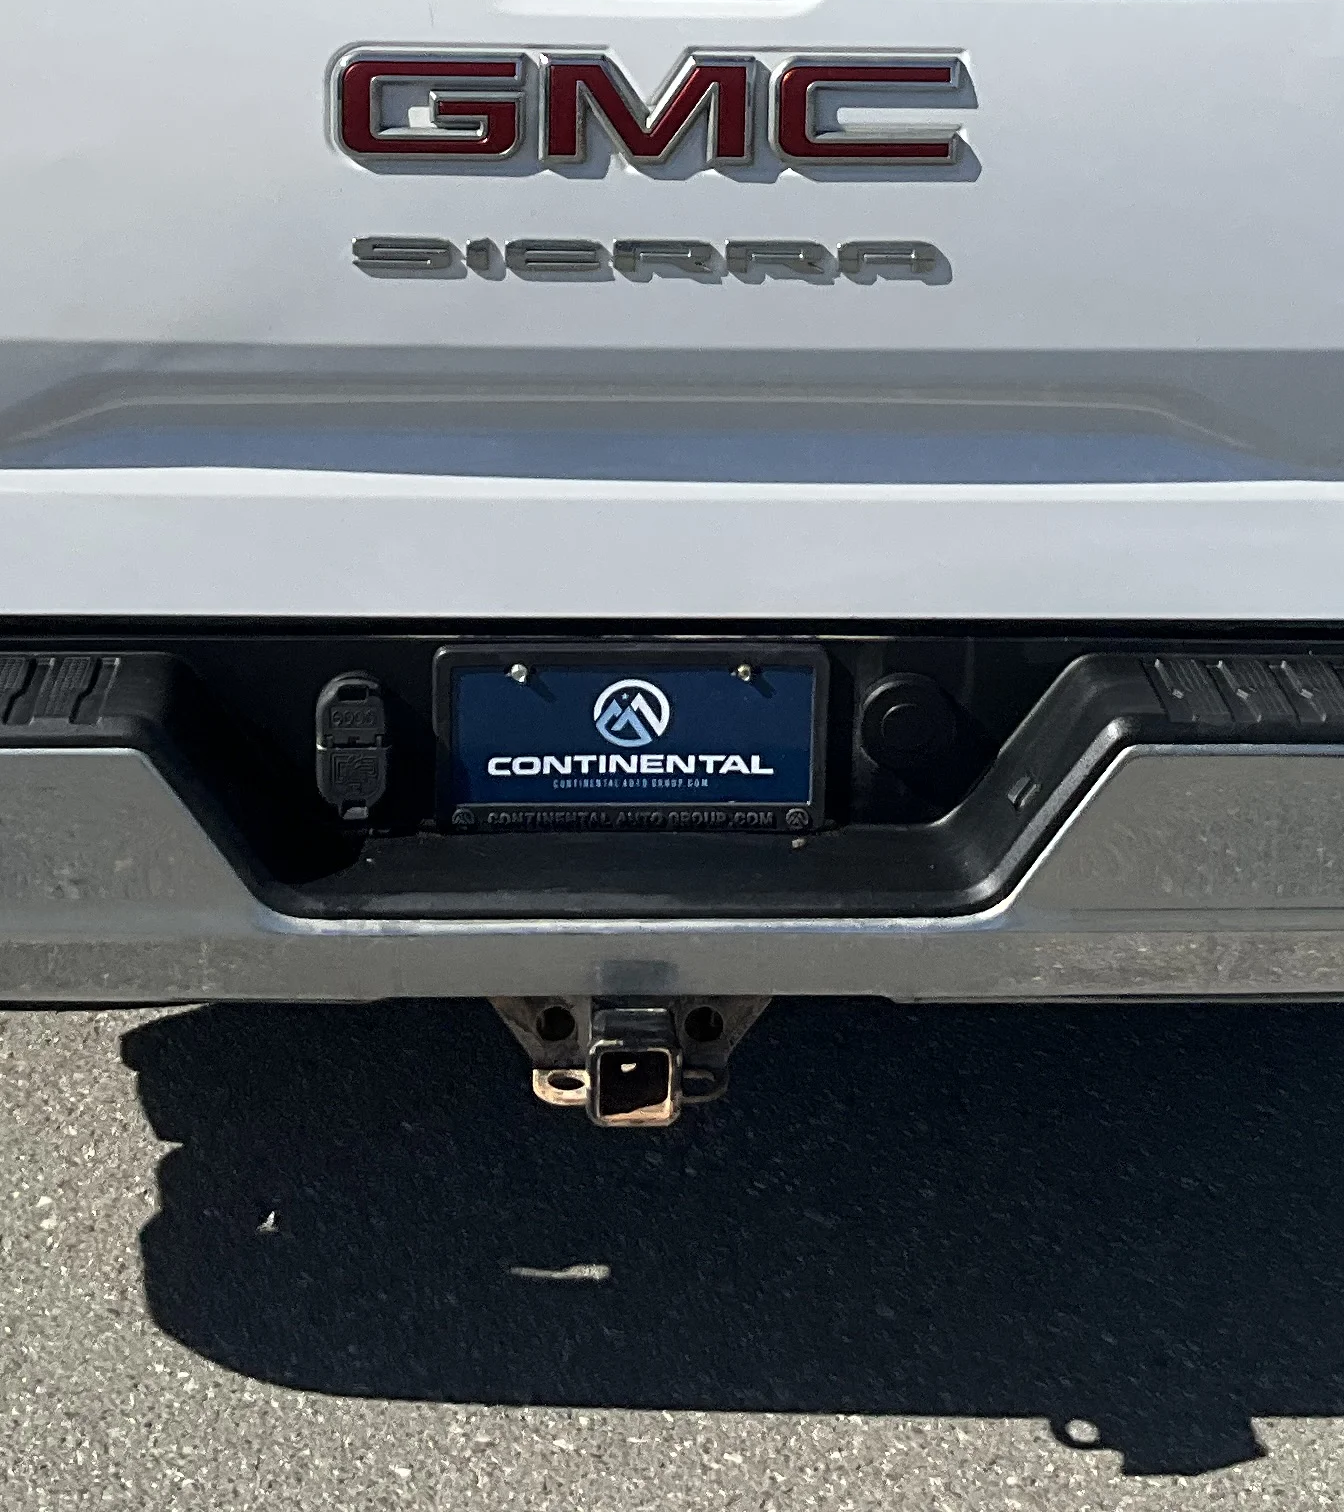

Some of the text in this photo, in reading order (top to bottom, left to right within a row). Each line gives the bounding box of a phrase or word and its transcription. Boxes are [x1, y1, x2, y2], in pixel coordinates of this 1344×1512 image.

[334, 48, 968, 166] GMC
[351, 236, 946, 279] SIERRA
[487, 755, 775, 776] CONTINENTAL
[487, 811, 611, 827] CONTINENTAL
